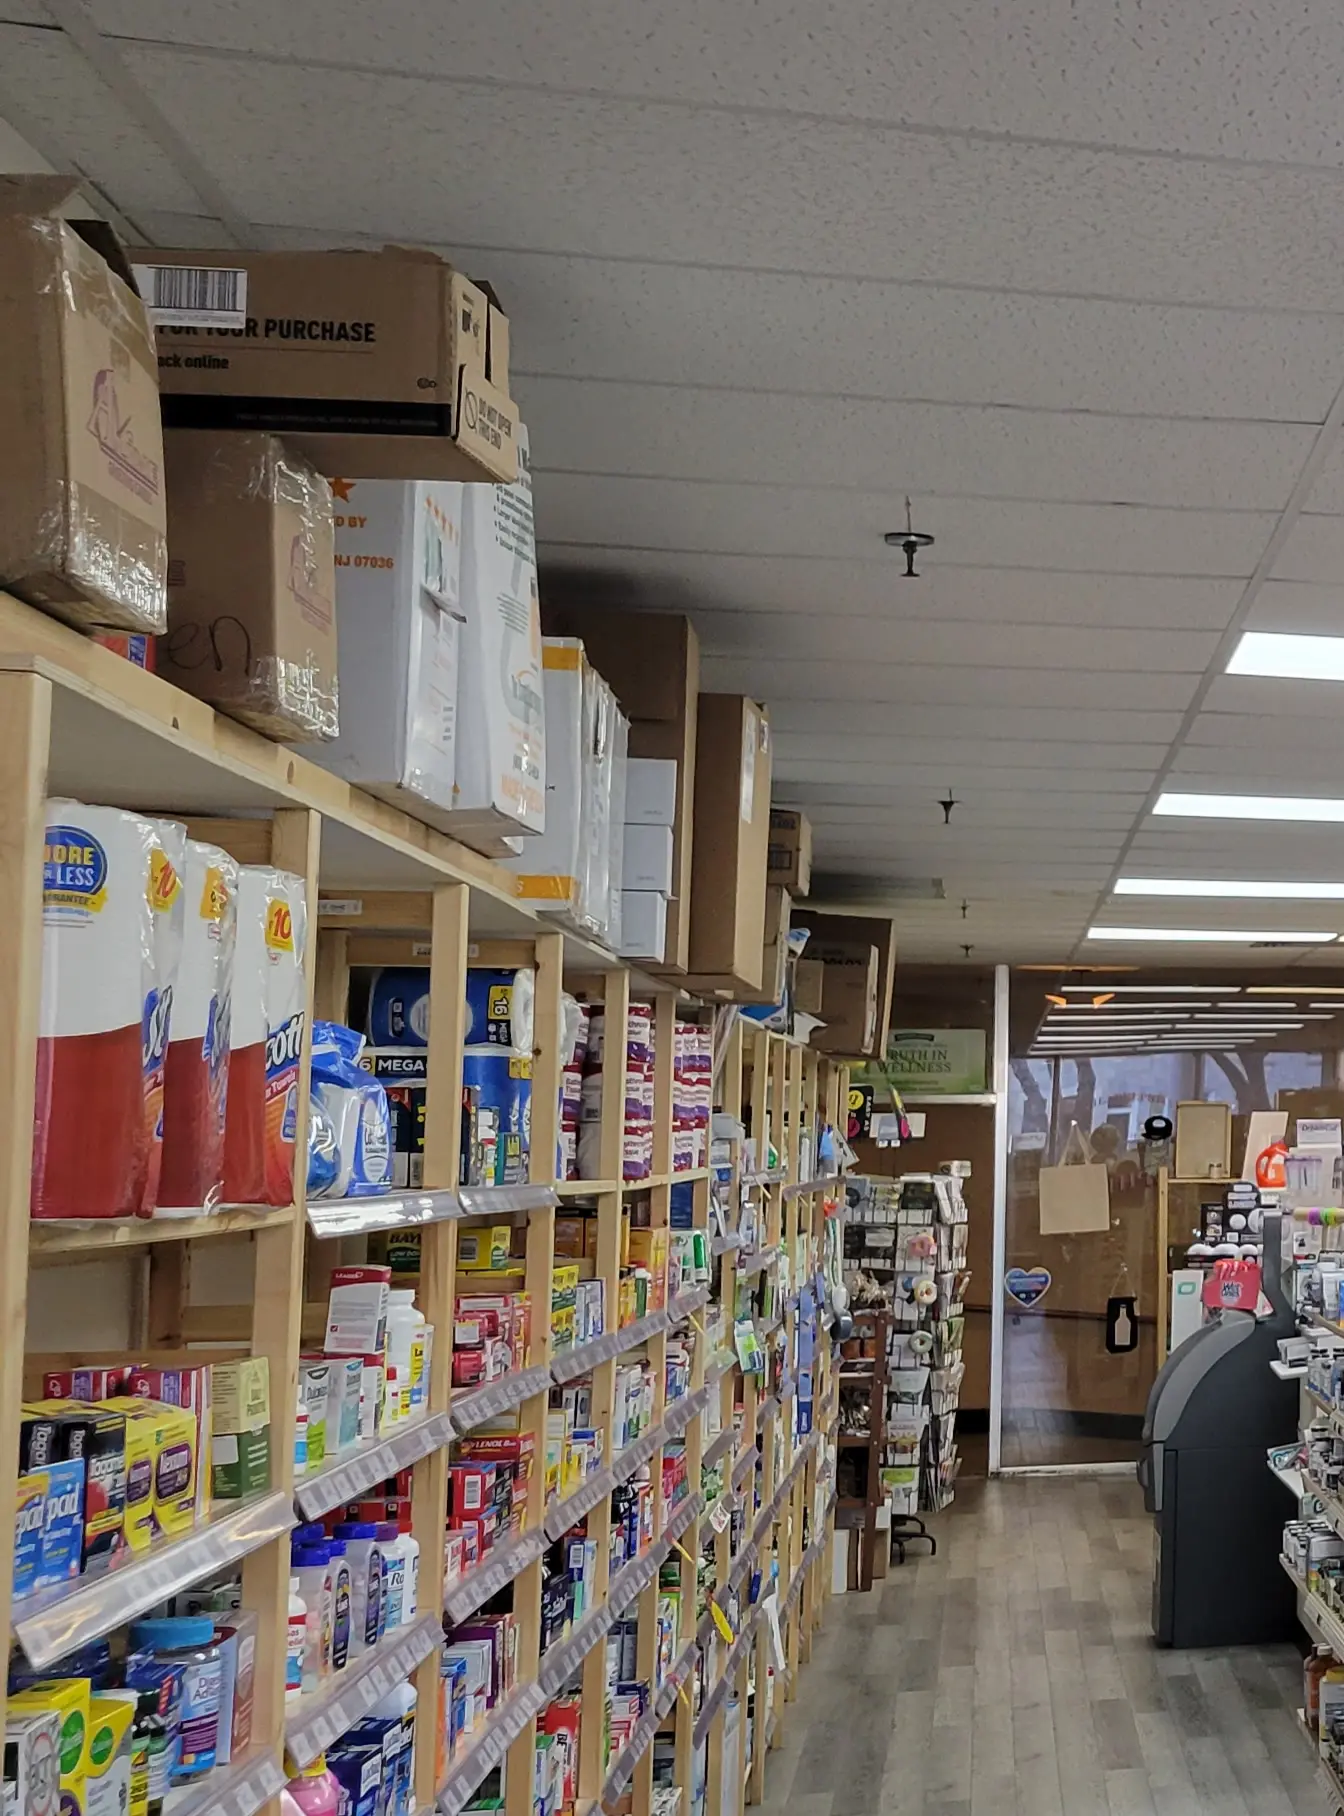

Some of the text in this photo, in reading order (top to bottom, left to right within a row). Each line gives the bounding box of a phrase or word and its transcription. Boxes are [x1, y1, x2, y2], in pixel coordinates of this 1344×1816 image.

[264, 319, 376, 343] PURCHASE
[185, 355, 229, 370] online
[348, 516, 367, 529] BY
[333, 554, 394, 570] NJ 07036
[56, 866, 95, 887] LESS
[273, 907, 291, 940] 10
[493, 996, 508, 1015] 16
[931, 1049, 948, 1061] IN
[377, 1055, 425, 1072] MEGA
[878, 1061, 952, 1074] WELLNESS
[389, 1231, 421, 1245] BAY
